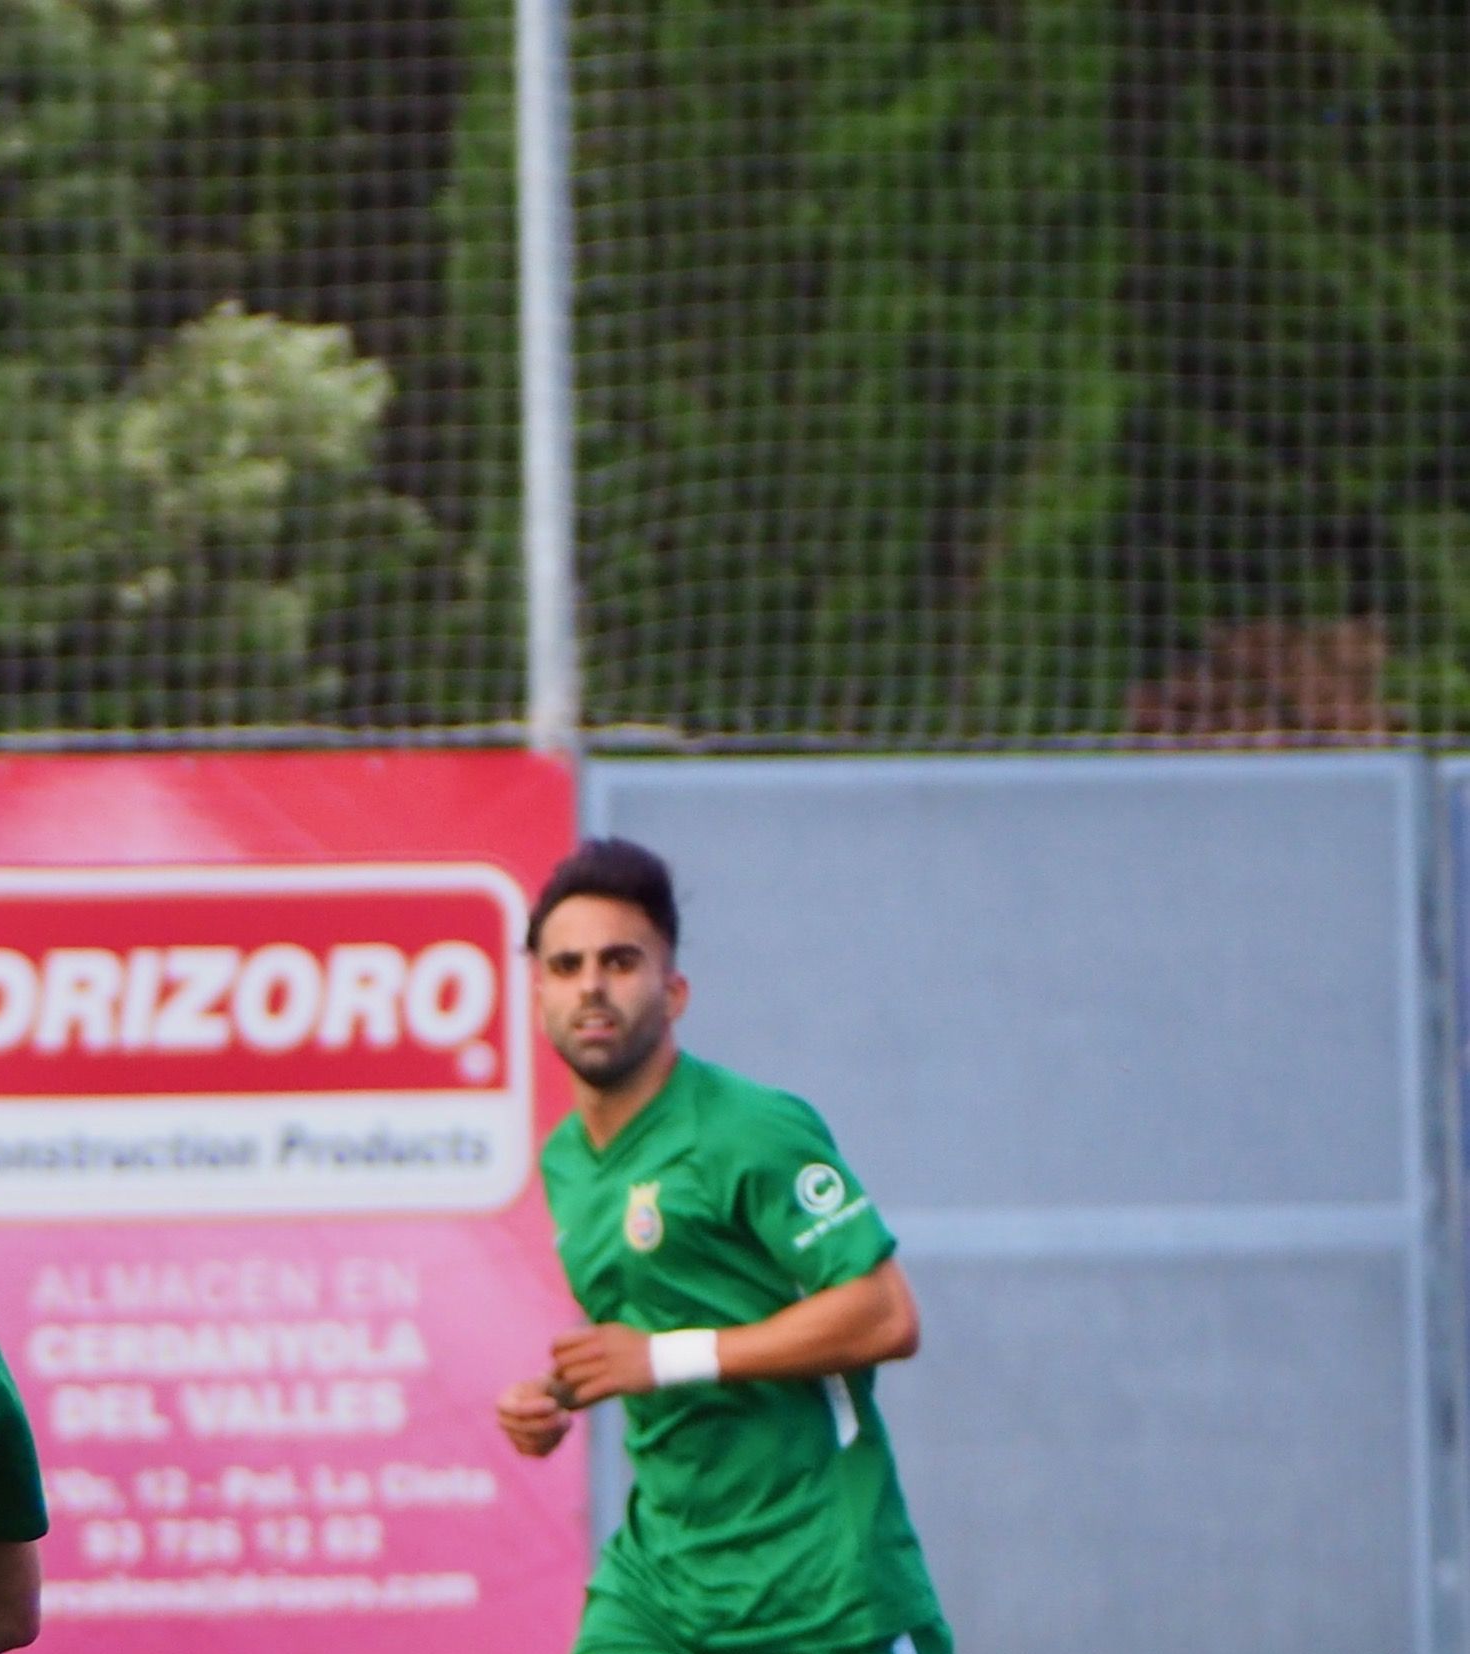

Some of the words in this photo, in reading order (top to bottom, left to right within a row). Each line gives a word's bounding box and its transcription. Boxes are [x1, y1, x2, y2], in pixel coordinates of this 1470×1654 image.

[277, 1117, 491, 1168] Products
[333, 1256, 422, 1308] EN
[27, 1319, 427, 1378] CERDANYOLA
[50, 1382, 172, 1440] DEL
[179, 1379, 409, 1438] VALLES
